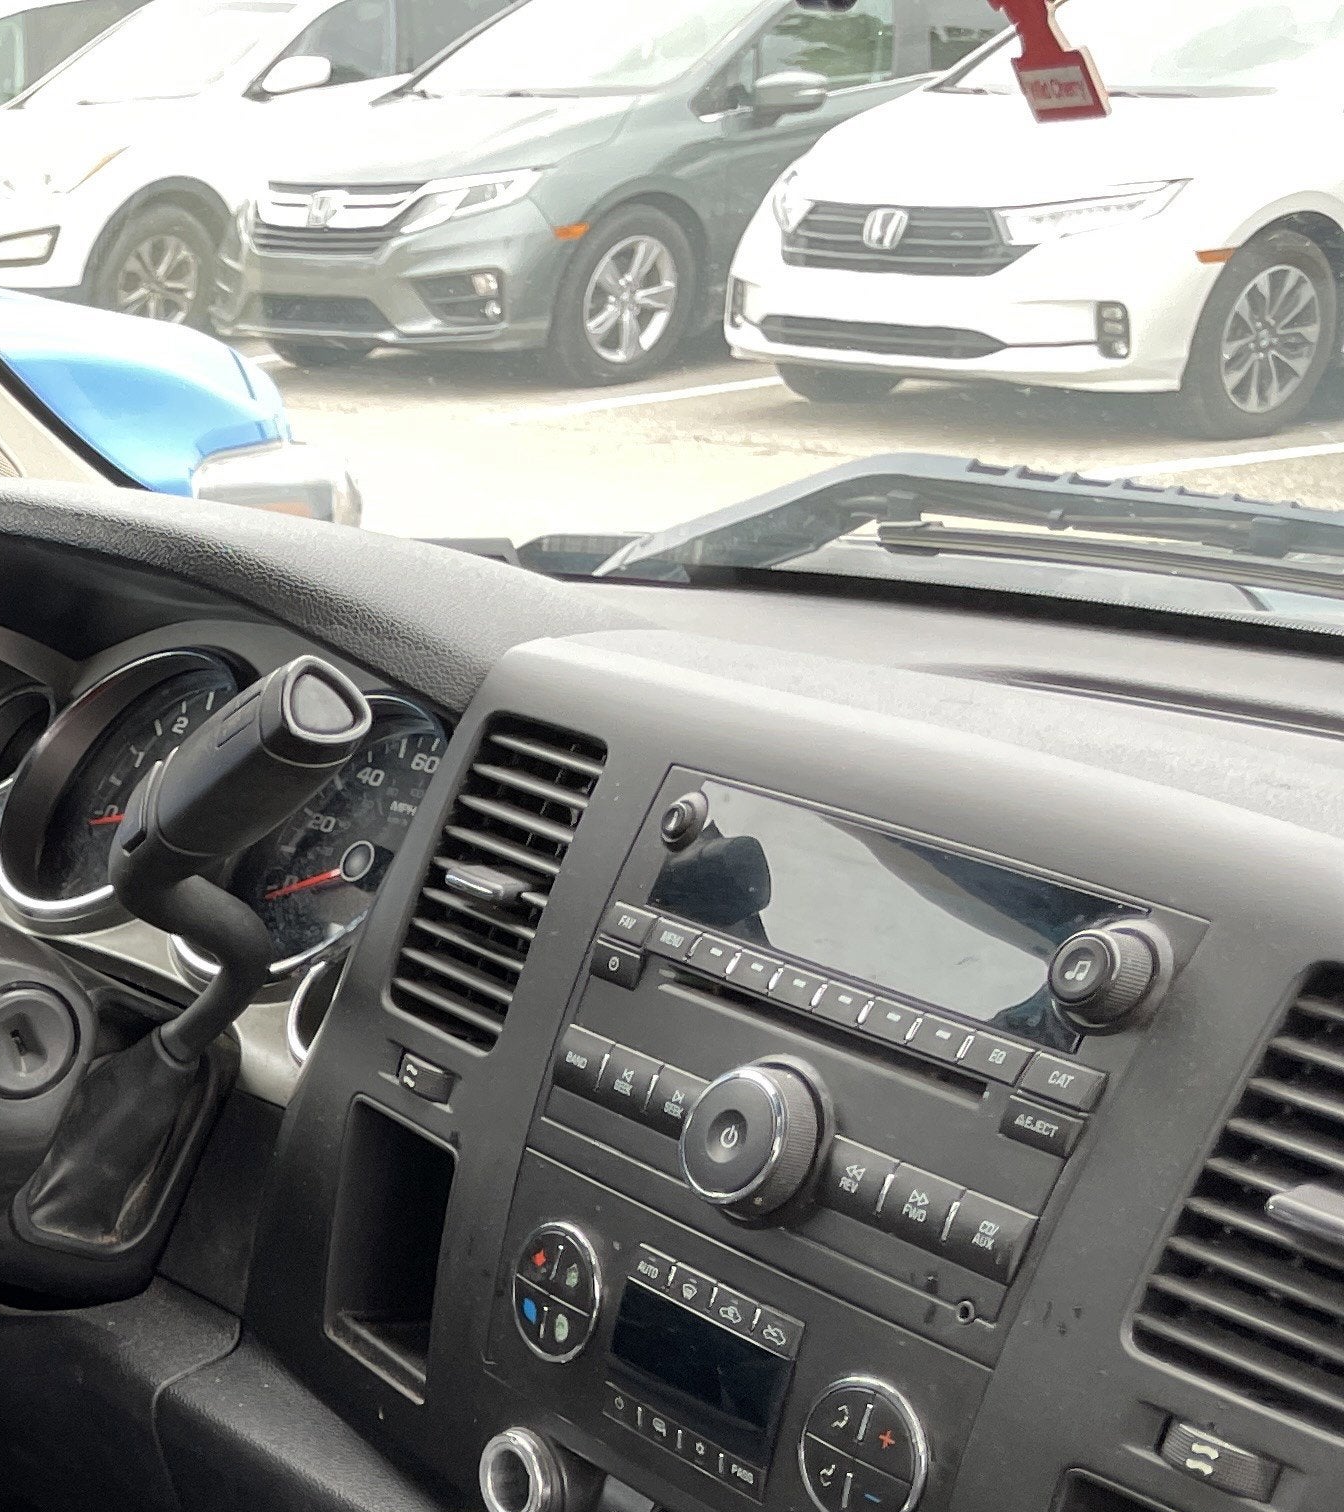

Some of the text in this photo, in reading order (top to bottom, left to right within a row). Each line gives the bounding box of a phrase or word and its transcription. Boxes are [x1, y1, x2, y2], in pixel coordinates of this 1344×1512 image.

[171, 716, 189, 734] 2
[411, 753, 440, 774] 60
[356, 767, 385, 787] 40
[309, 814, 336, 833] 20
[616, 914, 637, 930] FAV
[565, 1050, 589, 1070] BAND
[988, 1048, 1007, 1065] EQ
[1047, 1070, 1075, 1089] CAT
[1026, 1115, 1059, 1138] EJECT
[838, 1176, 860, 1194] REV
[901, 1203, 927, 1223] FWD
[637, 1260, 660, 1280] AUTO
